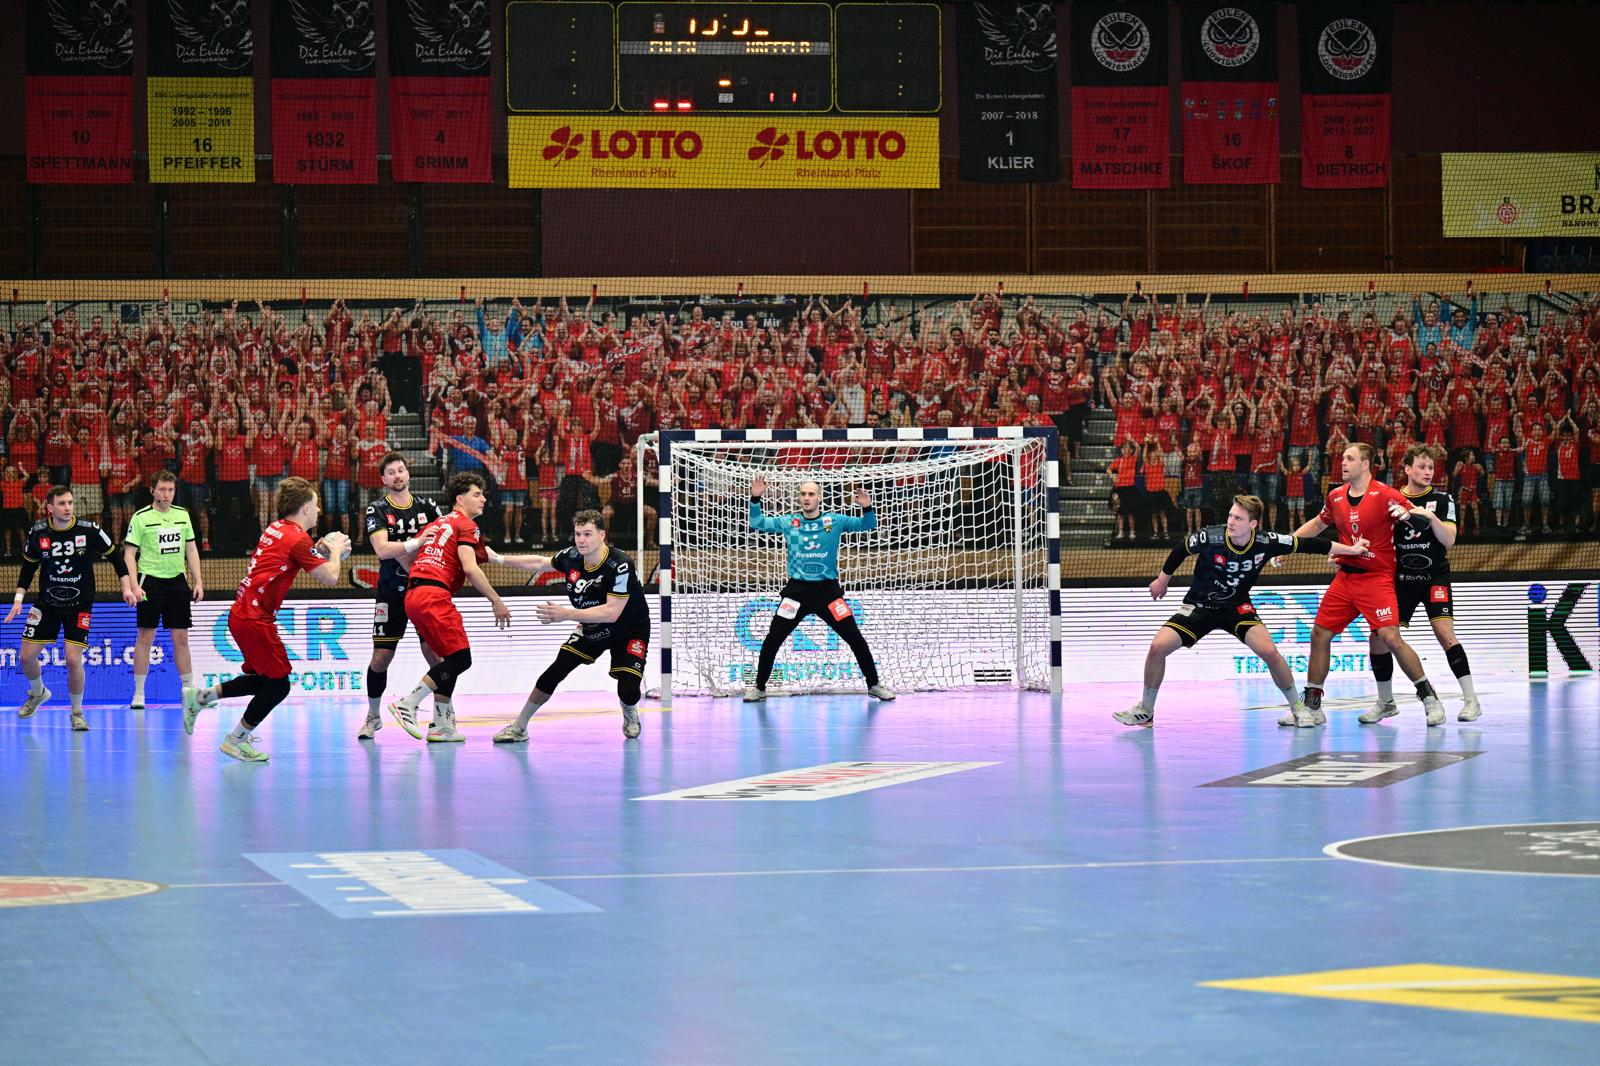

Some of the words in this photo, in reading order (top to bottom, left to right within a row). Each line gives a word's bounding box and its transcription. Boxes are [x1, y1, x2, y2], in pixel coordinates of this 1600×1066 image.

[1102, 12, 1139, 27] EULEN
[1211, 8, 1248, 21] EULEN
[1328, 20, 1367, 34] EULEN
[56, 41, 75, 54] Die
[79, 38, 115, 54] Eulen
[176, 43, 197, 57] Die
[200, 41, 236, 56] Eulen
[299, 45, 320, 59] Die
[322, 43, 357, 58] Eulen
[416, 43, 435, 57] Die
[437, 41, 472, 56] Eulen
[984, 46, 1003, 60] Die
[1006, 44, 1041, 59] Eulen
[172, 107, 197, 116] 1992
[980, 112, 1004, 120] 2007
[1015, 112, 1039, 120] 2018
[172, 119, 197, 128] 2005
[208, 119, 232, 128] 2011
[72, 130, 91, 144] 10
[307, 133, 346, 147] 1932
[435, 130, 446, 144] 4
[1005, 131, 1015, 146] 1
[1113, 128, 1132, 140] 17
[1222, 133, 1243, 147] 16
[193, 137, 213, 152] 16
[591, 130, 702, 159] LOTTO
[796, 130, 907, 159] LOTTO
[30, 157, 130, 169] SPETTMANN
[163, 157, 242, 169] PFEIFFER
[415, 156, 468, 169] GRIMM
[987, 156, 1035, 169] KLIER
[1081, 162, 1164, 175] MATSCHKE
[1316, 162, 1386, 176] DIETRICH
[591, 167, 678, 180] Rheinland-Pfalz
[796, 167, 882, 180] Rheinland-Pfalz
[1561, 194, 1600, 215] BR
[396, 517, 418, 533] 11
[804, 523, 820, 532] 12
[51, 541, 75, 557] 23
[1226, 560, 1253, 573] 33
